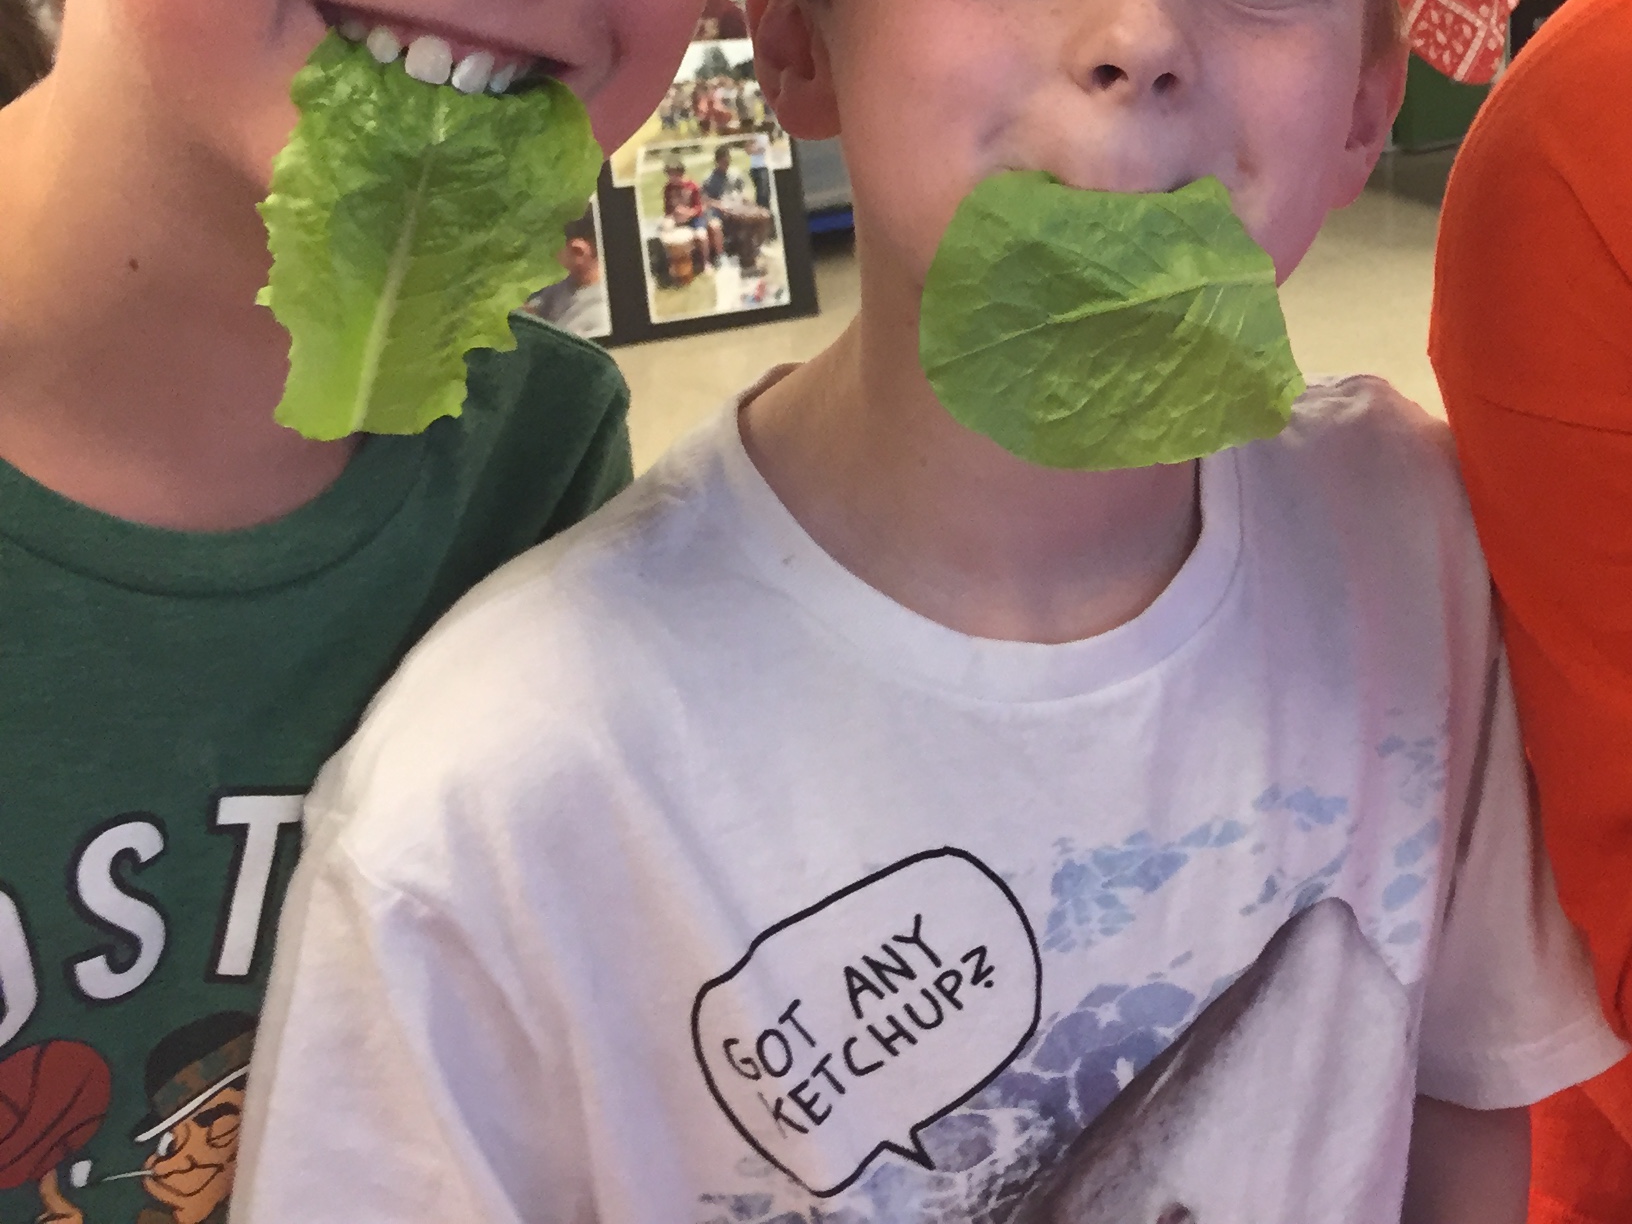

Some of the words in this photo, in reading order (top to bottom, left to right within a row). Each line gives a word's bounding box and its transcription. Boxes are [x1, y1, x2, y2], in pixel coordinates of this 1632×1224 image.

[723, 999, 816, 1081] GOT
[843, 913, 942, 1019] ANY
[758, 944, 995, 1139] KETCHUP?
